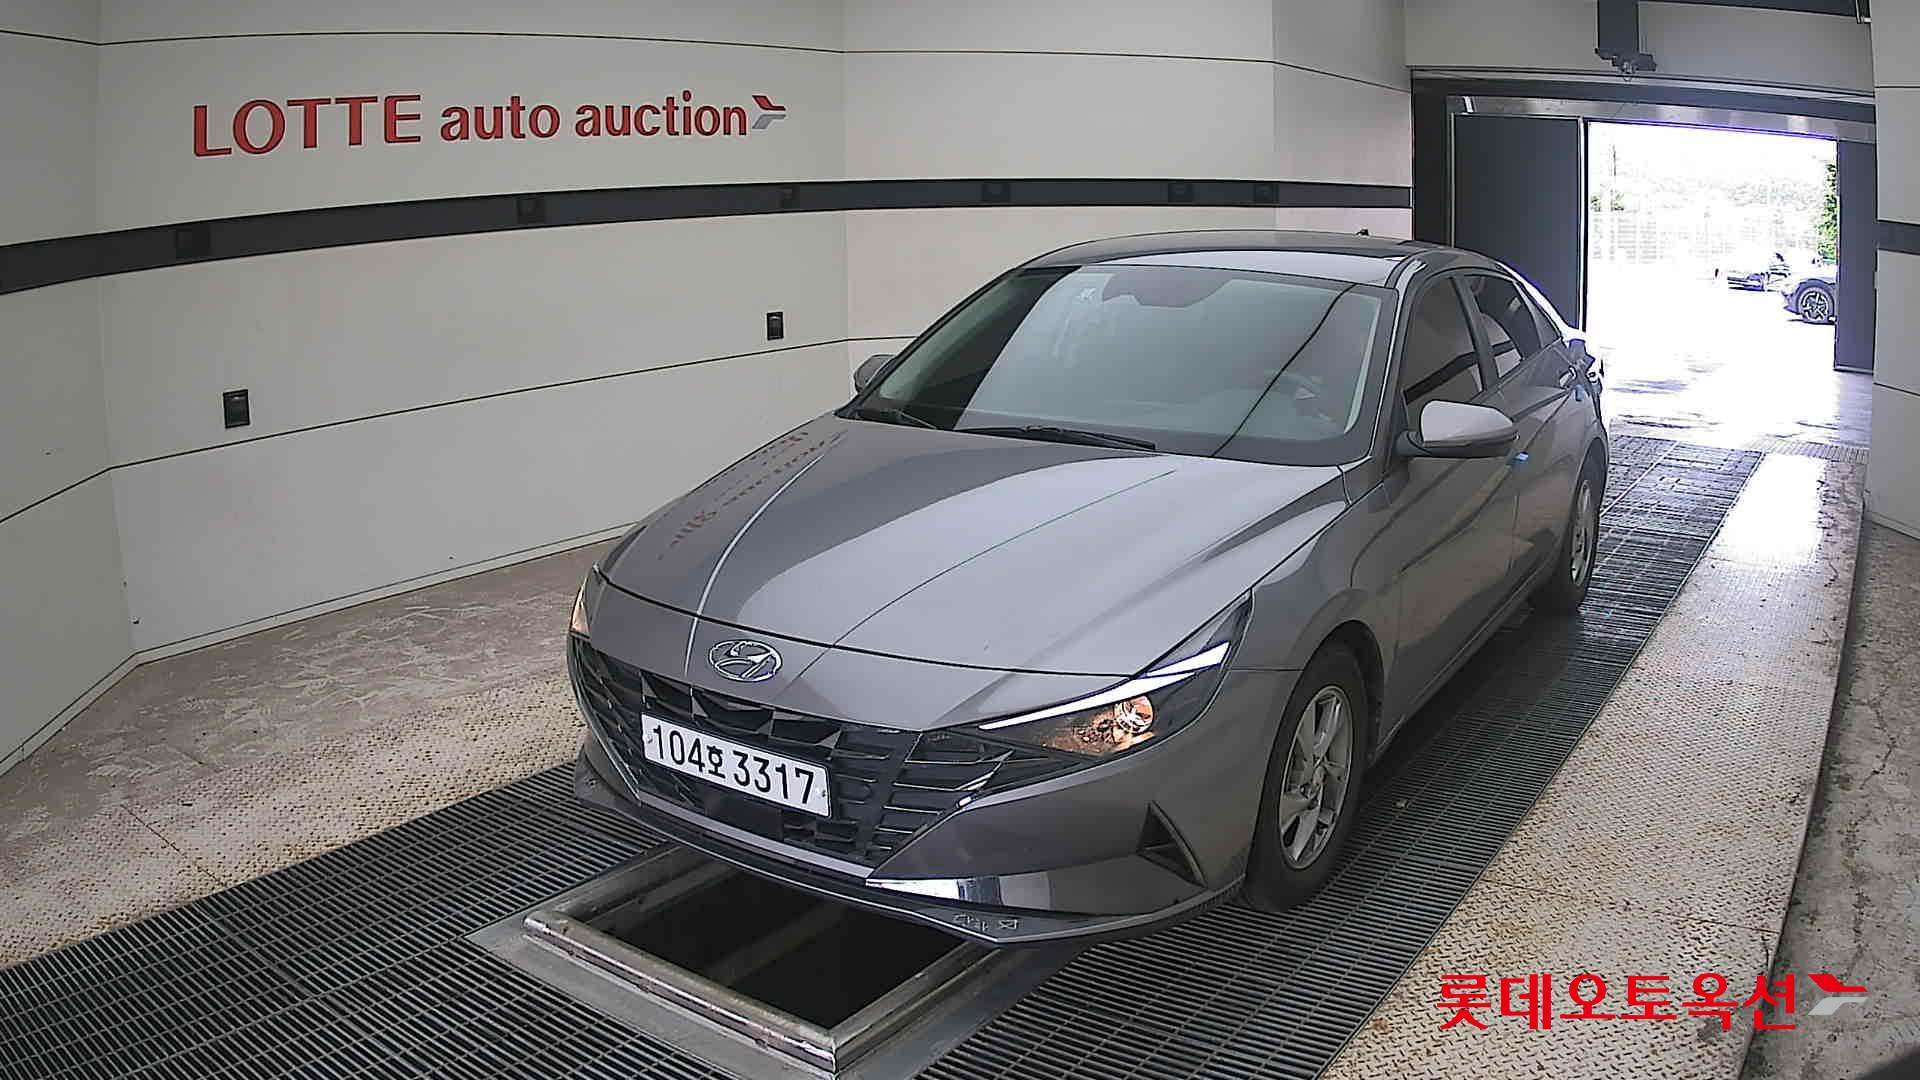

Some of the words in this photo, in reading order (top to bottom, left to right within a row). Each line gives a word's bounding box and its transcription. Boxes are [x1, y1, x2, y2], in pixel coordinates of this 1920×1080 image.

[193, 95, 422, 157] LOTTE
[440, 95, 561, 140] auto
[575, 91, 747, 138] auction
[653, 725, 726, 779] 104호
[732, 750, 814, 804] 3317
